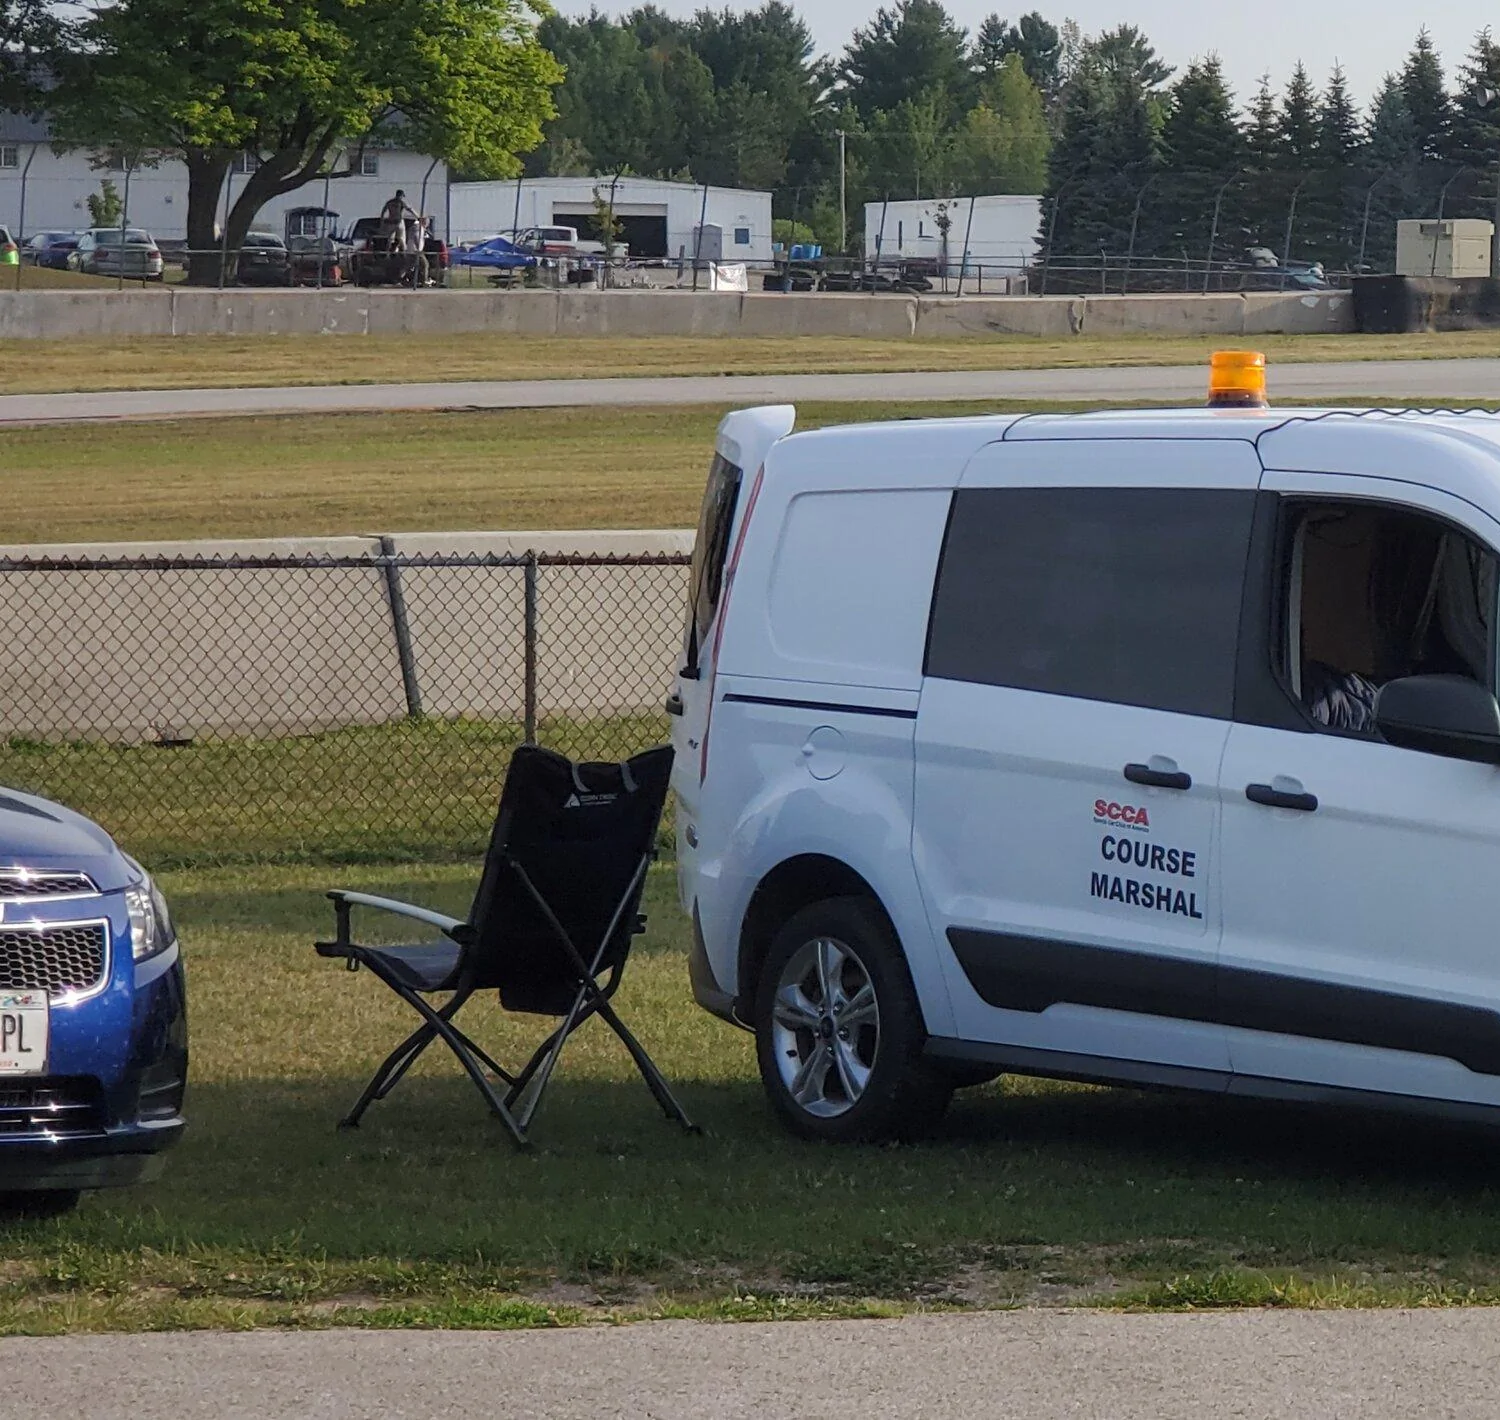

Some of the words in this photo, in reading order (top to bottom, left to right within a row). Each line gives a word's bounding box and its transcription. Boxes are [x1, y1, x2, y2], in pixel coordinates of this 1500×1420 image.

[1094, 799, 1149, 826] SCCA
[1101, 835, 1196, 877] COURSE
[1091, 872, 1202, 919] MARSHAL
